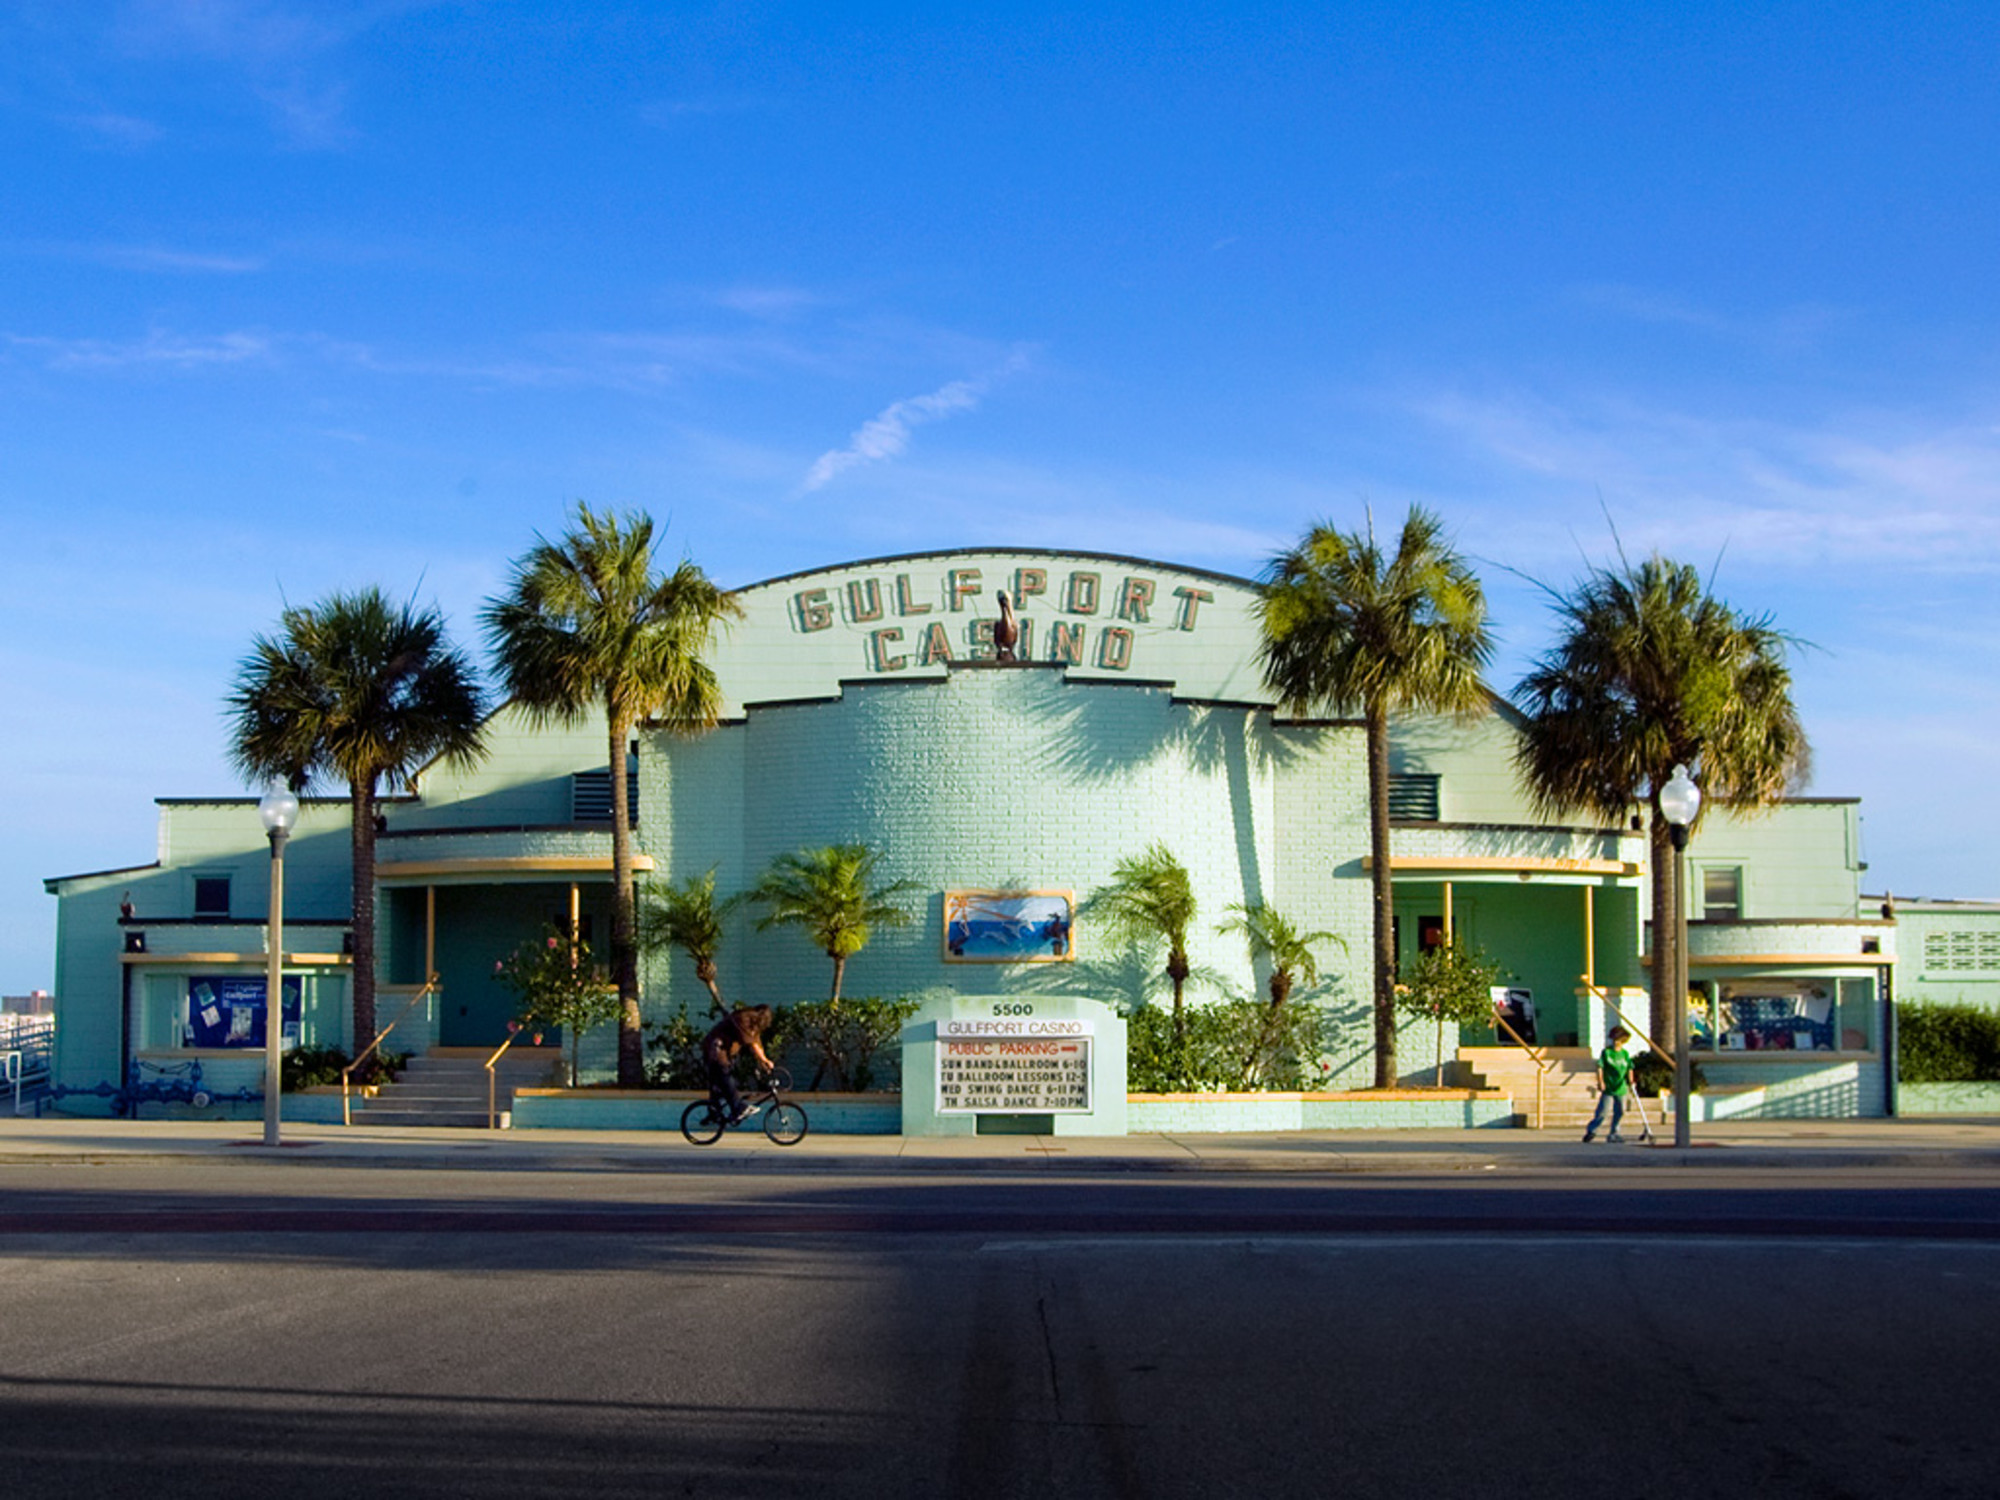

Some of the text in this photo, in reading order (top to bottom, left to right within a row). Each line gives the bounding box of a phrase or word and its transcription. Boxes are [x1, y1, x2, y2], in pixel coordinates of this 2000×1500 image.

[790, 567, 1215, 633] GULFPORT
[867, 617, 1134, 672] CASINO
[993, 1004, 1033, 1016] 5500
[948, 1022, 1083, 1034] GULFPORT CASINO
[948, 1042, 1059, 1055] PUBLIC PARKING
[941, 1060, 962, 1069] SUN
[1063, 1060, 1087, 1069] 6-10
[941, 1072, 954, 1082] TU
[958, 1072, 1014, 1082] BALLROOM
[1017, 1072, 1063, 1082] LESSONS
[941, 1084, 1085, 1094] WED SWING DANCE 6-11 PM
[965, 1097, 998, 1107] SALSA
[1004, 1097, 1037, 1107] DANCE
